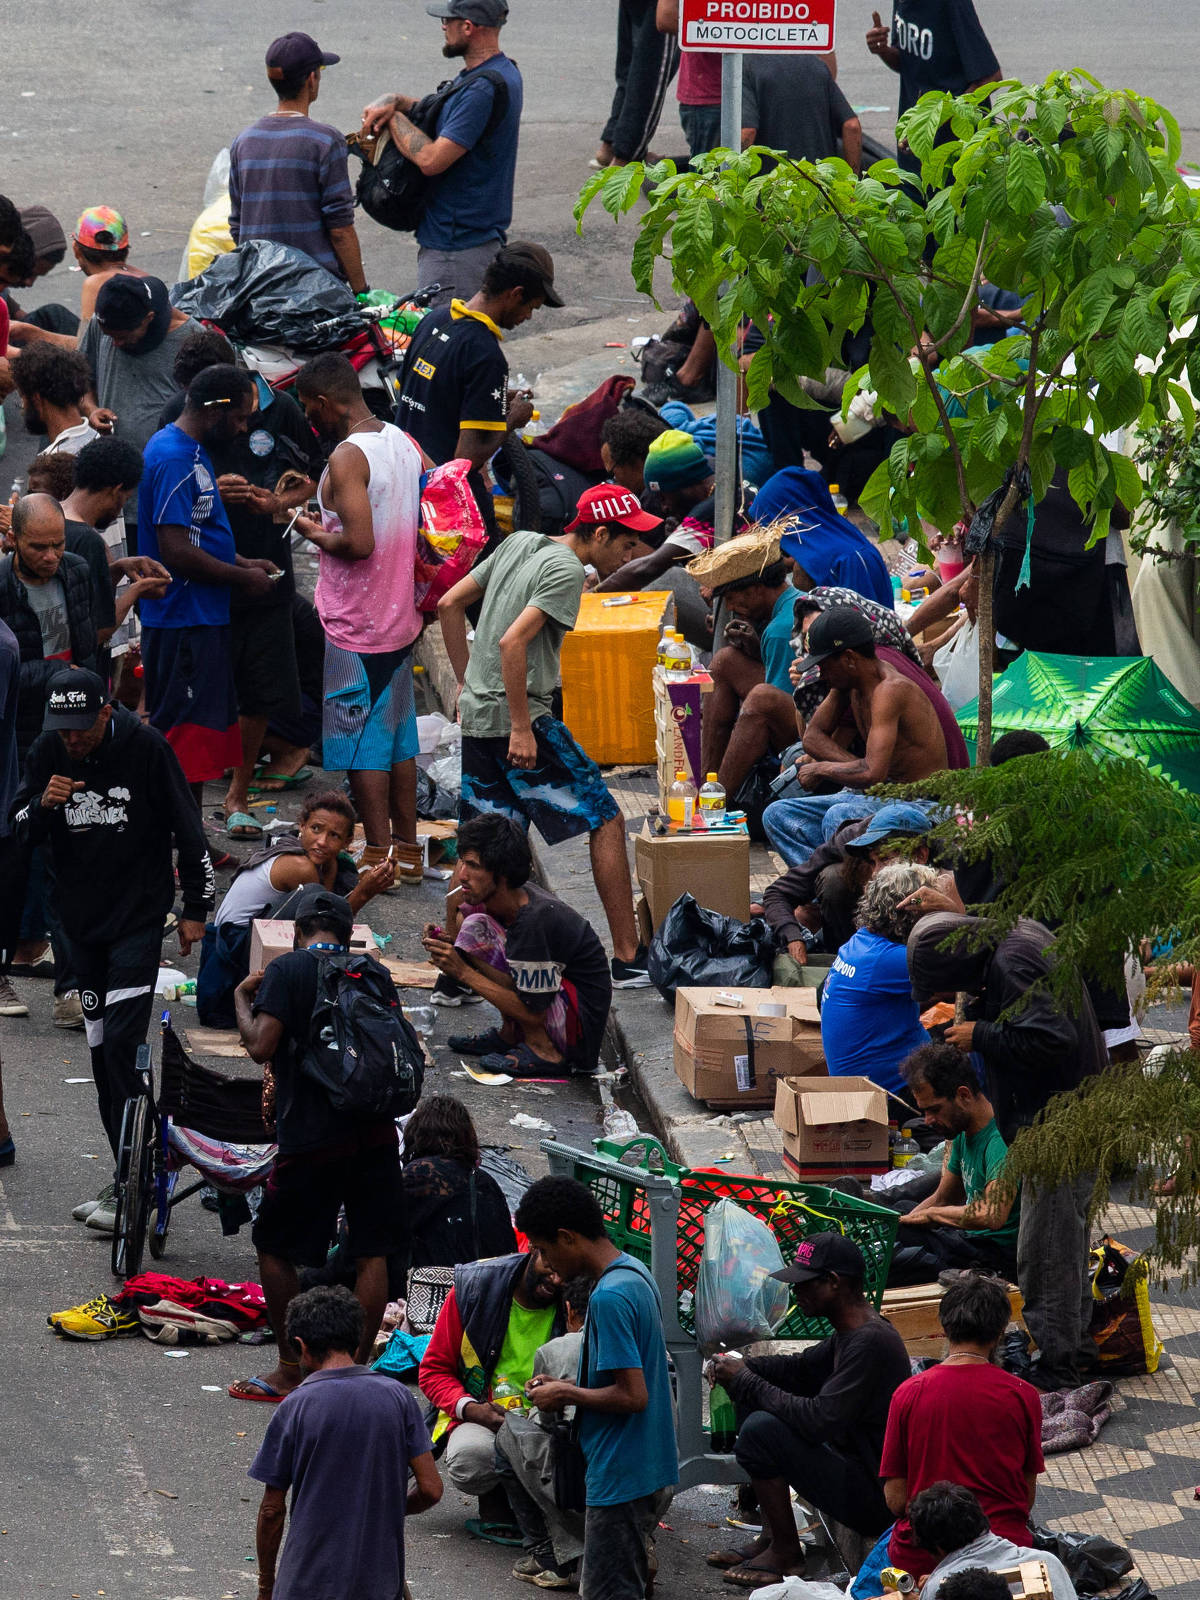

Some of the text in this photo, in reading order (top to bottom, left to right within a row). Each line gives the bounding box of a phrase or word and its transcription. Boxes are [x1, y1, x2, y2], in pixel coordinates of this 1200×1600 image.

[707, 2, 810, 19] PROIBIDO
[696, 26, 818, 41] MOTOCICLETA
[673, 725, 685, 777] LANDFR
[84, 994, 94, 1006] FC
